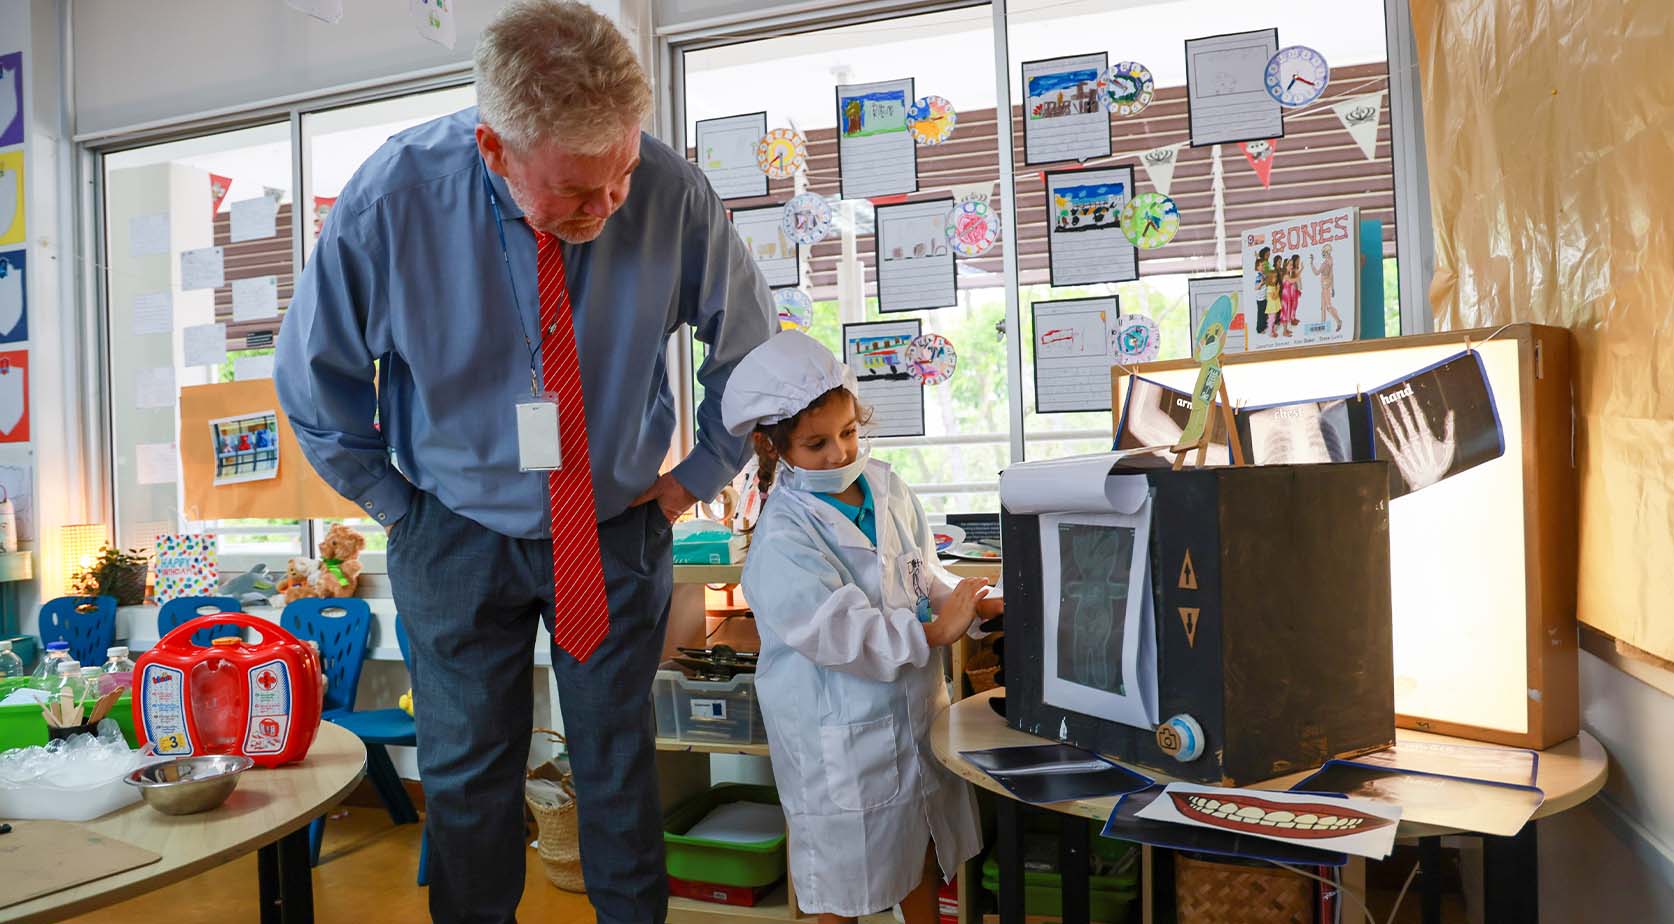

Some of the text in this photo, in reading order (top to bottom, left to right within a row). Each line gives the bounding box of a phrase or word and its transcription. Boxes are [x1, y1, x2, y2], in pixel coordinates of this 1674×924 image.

[1272, 215, 1348, 253] BONES
[1379, 383, 1414, 405] hand
[1274, 407, 1305, 420] chest
[160, 557, 190, 568] HAPPY
[169, 735, 179, 748] 3
